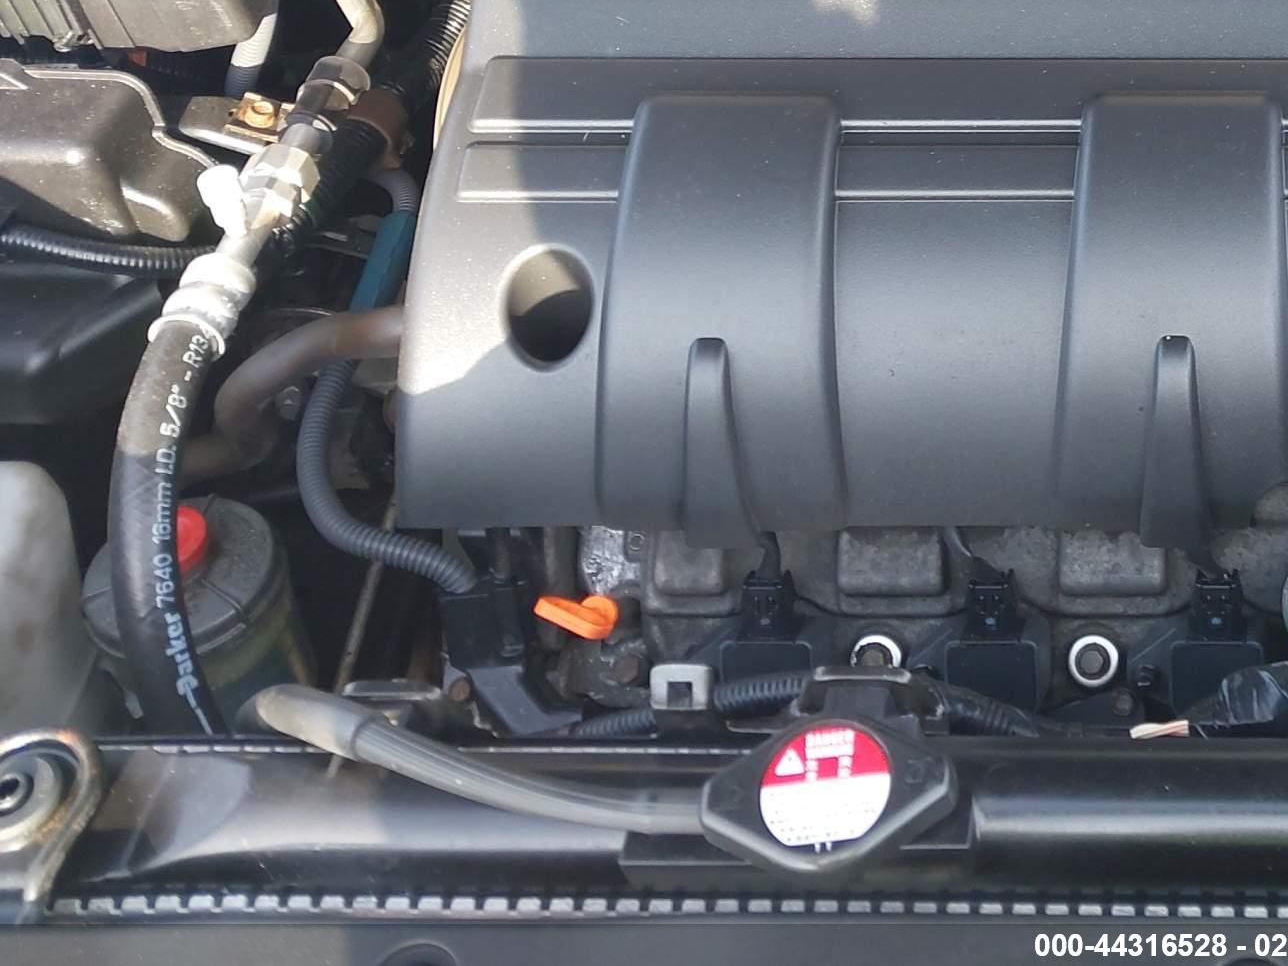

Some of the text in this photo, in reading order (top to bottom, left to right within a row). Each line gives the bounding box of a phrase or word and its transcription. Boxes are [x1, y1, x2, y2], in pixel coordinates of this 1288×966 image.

[152, 482, 172, 545] 16mm
[152, 553, 176, 608] 7640
[164, 612, 200, 696] Parker
